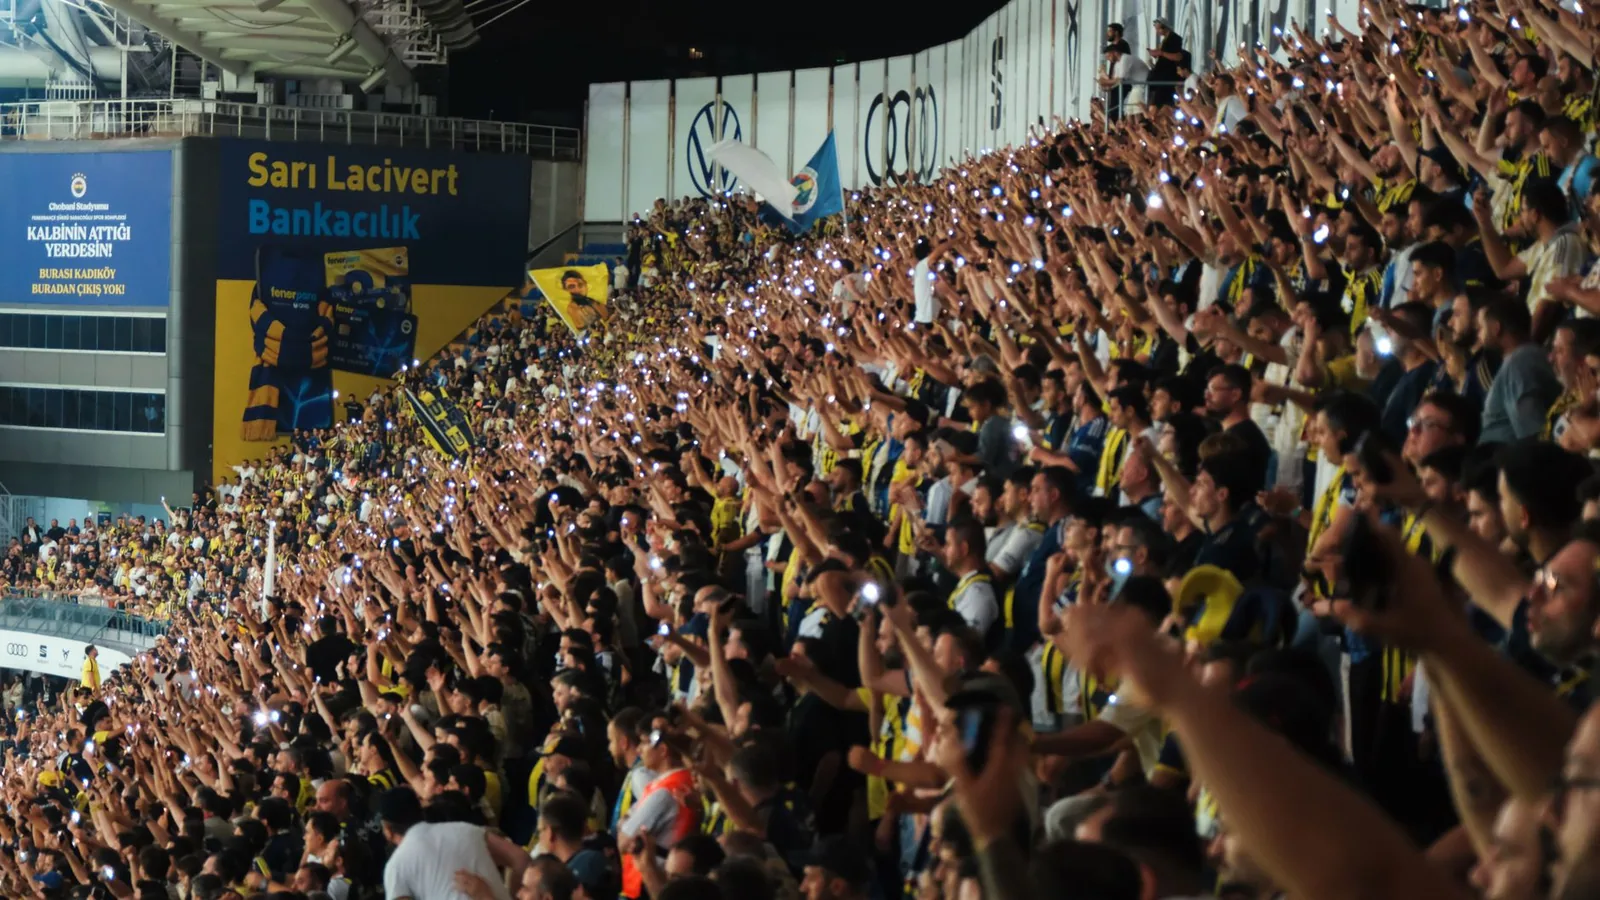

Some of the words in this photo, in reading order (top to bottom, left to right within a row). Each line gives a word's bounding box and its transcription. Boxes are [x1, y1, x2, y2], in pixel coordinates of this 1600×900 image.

[248, 151, 316, 189] Sarı
[327, 155, 459, 195] Lacivert
[249, 199, 421, 239] Bankacılık
[27, 223, 87, 240] KALBİNİN
[89, 222, 131, 240] ATTIĞI
[45, 240, 113, 257] YERDESİN!
[39, 268, 73, 279] BURASI
[74, 267, 116, 279] KADIKÖY
[31, 284, 75, 295] BURADAN
[77, 283, 102, 297] ÇIKIŞ
[103, 285, 125, 295] YOK!
